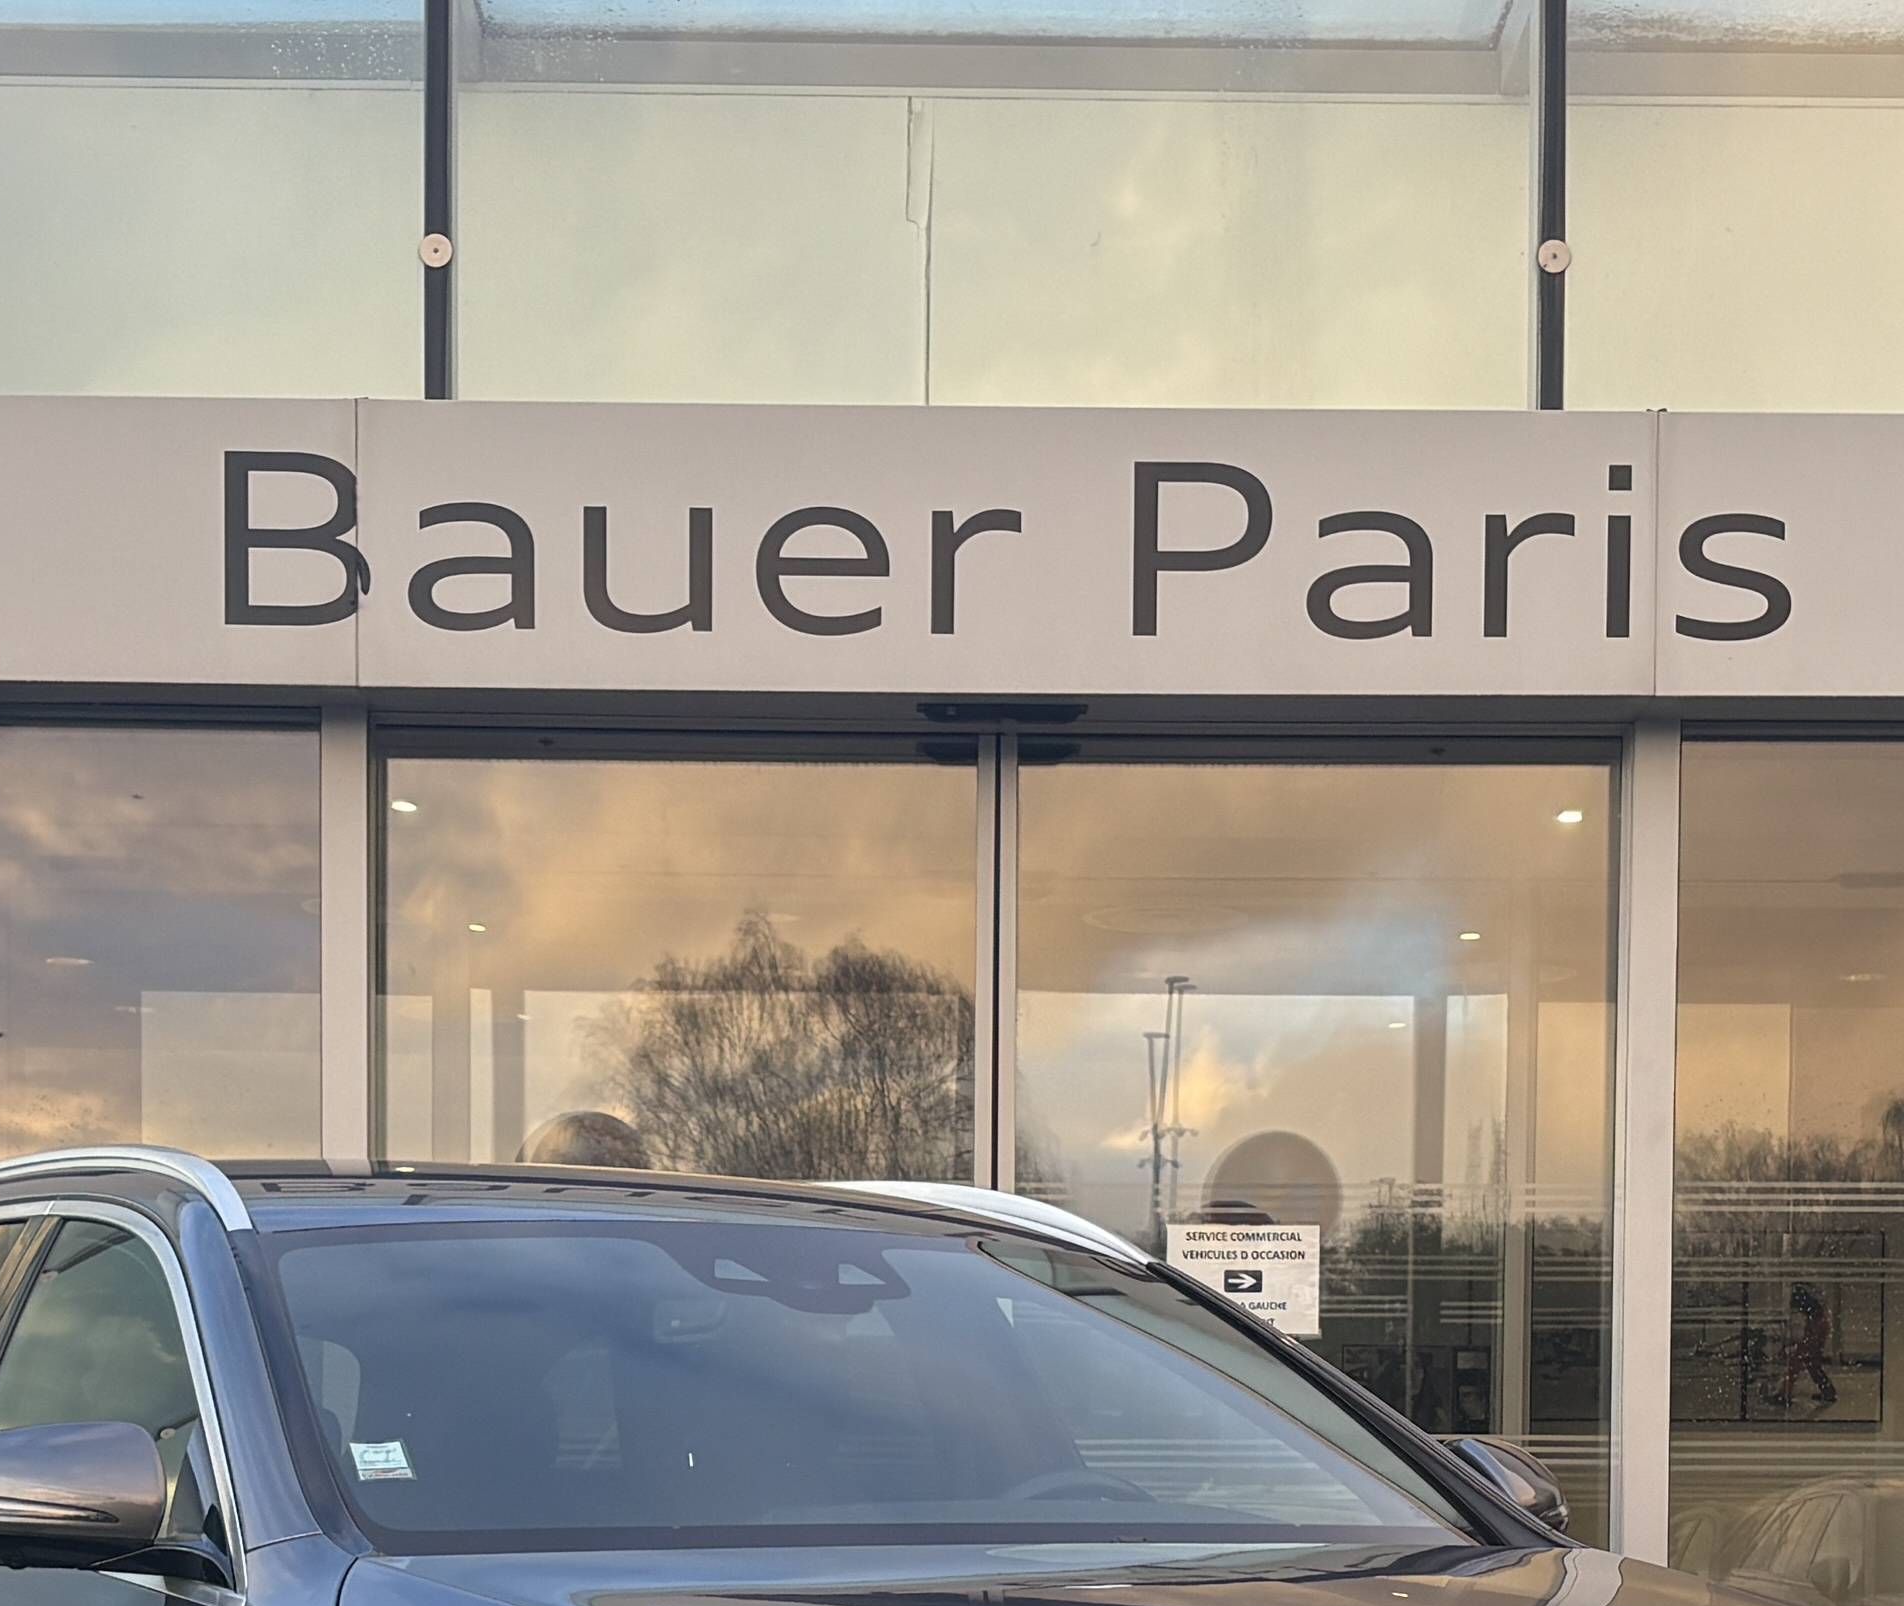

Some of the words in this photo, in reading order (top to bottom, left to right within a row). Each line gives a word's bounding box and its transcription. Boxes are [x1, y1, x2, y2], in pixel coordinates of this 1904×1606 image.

[223, 449, 1022, 636] Bauer
[1131, 460, 1793, 642] Paris
[1185, 1231, 1228, 1242] SERVICE
[1230, 1231, 1302, 1242] COMMERCIAL
